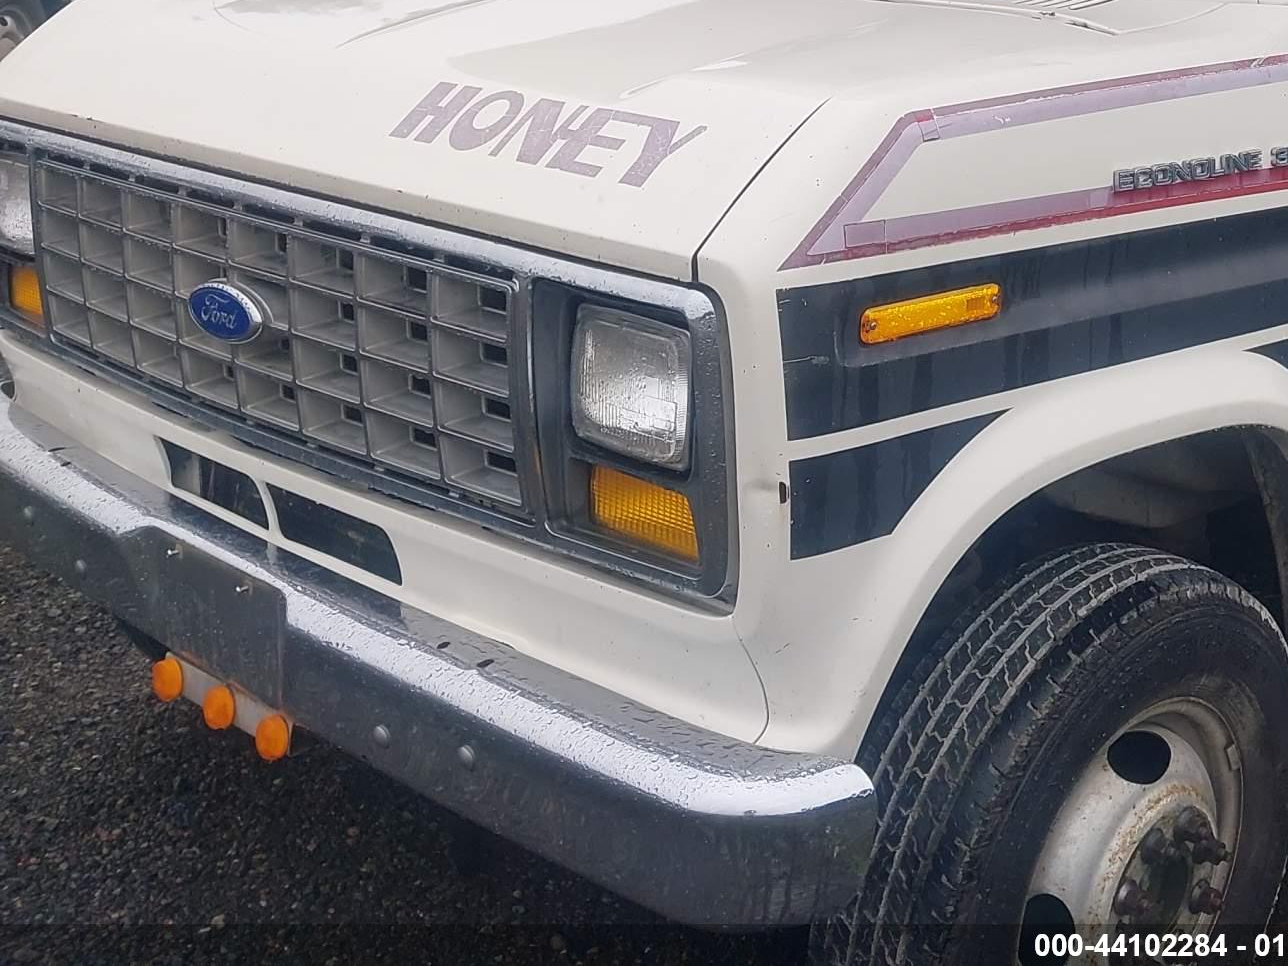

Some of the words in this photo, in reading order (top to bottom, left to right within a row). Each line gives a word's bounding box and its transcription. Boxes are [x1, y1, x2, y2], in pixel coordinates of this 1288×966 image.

[388, 80, 708, 188] HONEY
[1113, 148, 1262, 192] ECONOLINE
[201, 294, 238, 330] Ford
